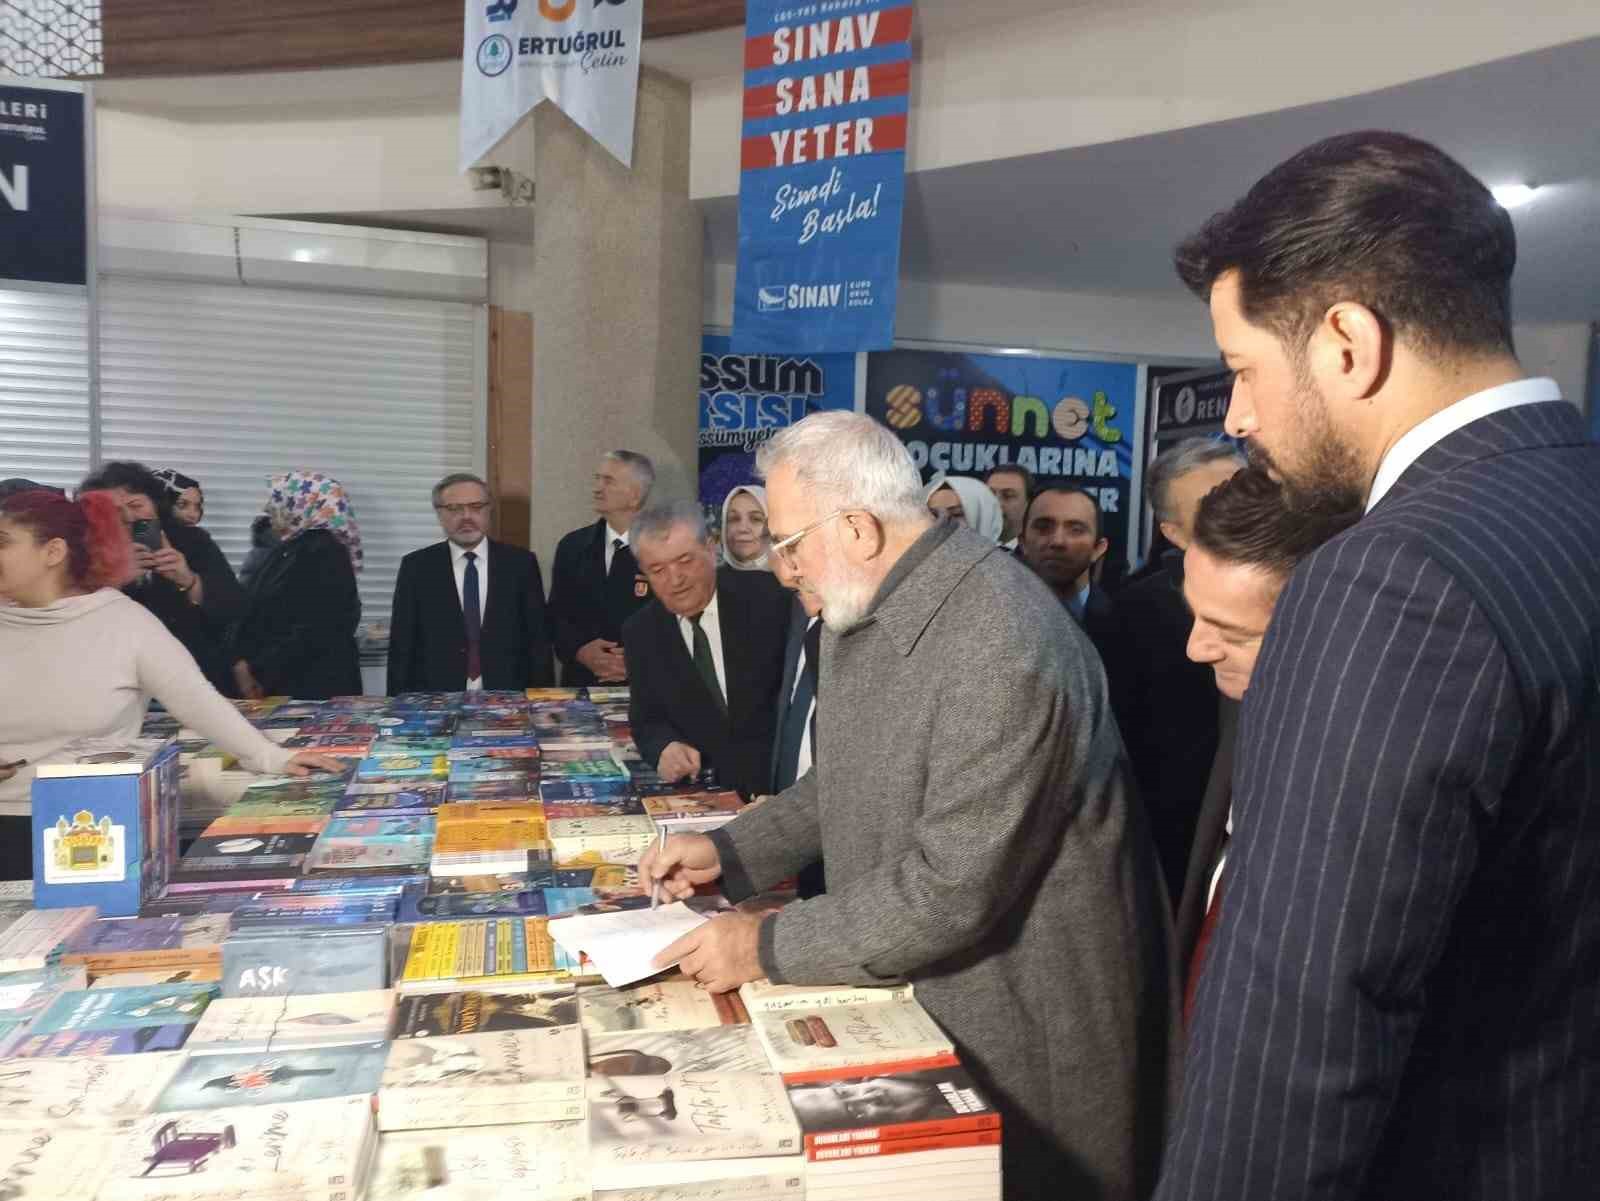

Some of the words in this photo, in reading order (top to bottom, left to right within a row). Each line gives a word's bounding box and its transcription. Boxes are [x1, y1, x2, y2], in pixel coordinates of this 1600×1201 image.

[518, 30, 626, 56] ERTUĞRUL
[580, 51, 628, 75] Çetin
[772, 10, 881, 66] SINAV
[776, 65, 870, 115] SANA
[770, 117, 874, 168] YETER
[770, 166, 842, 223] Şimdi
[798, 183, 881, 245] Başla!
[787, 283, 842, 309] SINAV
[905, 440, 1120, 478] OCUKLARINA
